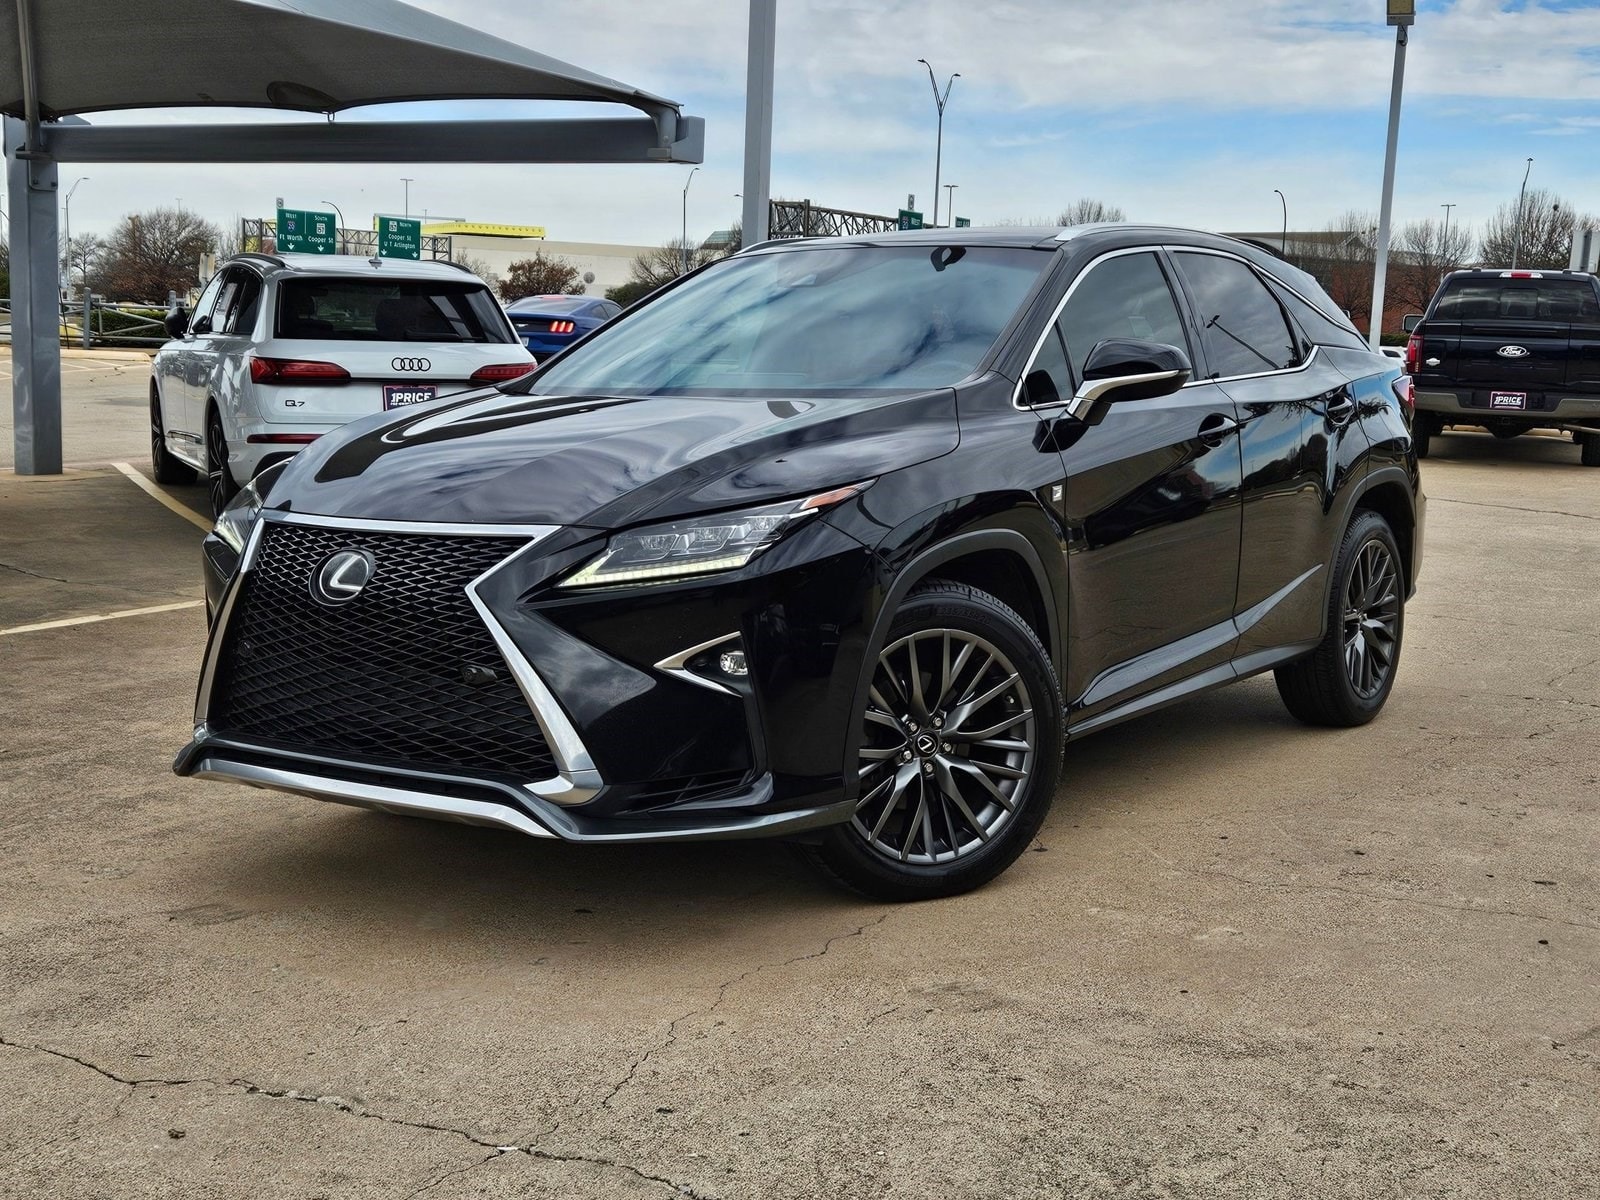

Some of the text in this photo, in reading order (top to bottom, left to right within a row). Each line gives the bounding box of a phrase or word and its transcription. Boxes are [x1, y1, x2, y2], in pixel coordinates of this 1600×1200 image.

[308, 235, 334, 244] Cooper St
[388, 233, 412, 242] Cooper St
[393, 241, 416, 250] Arlington
[285, 399, 306, 407] Q7
